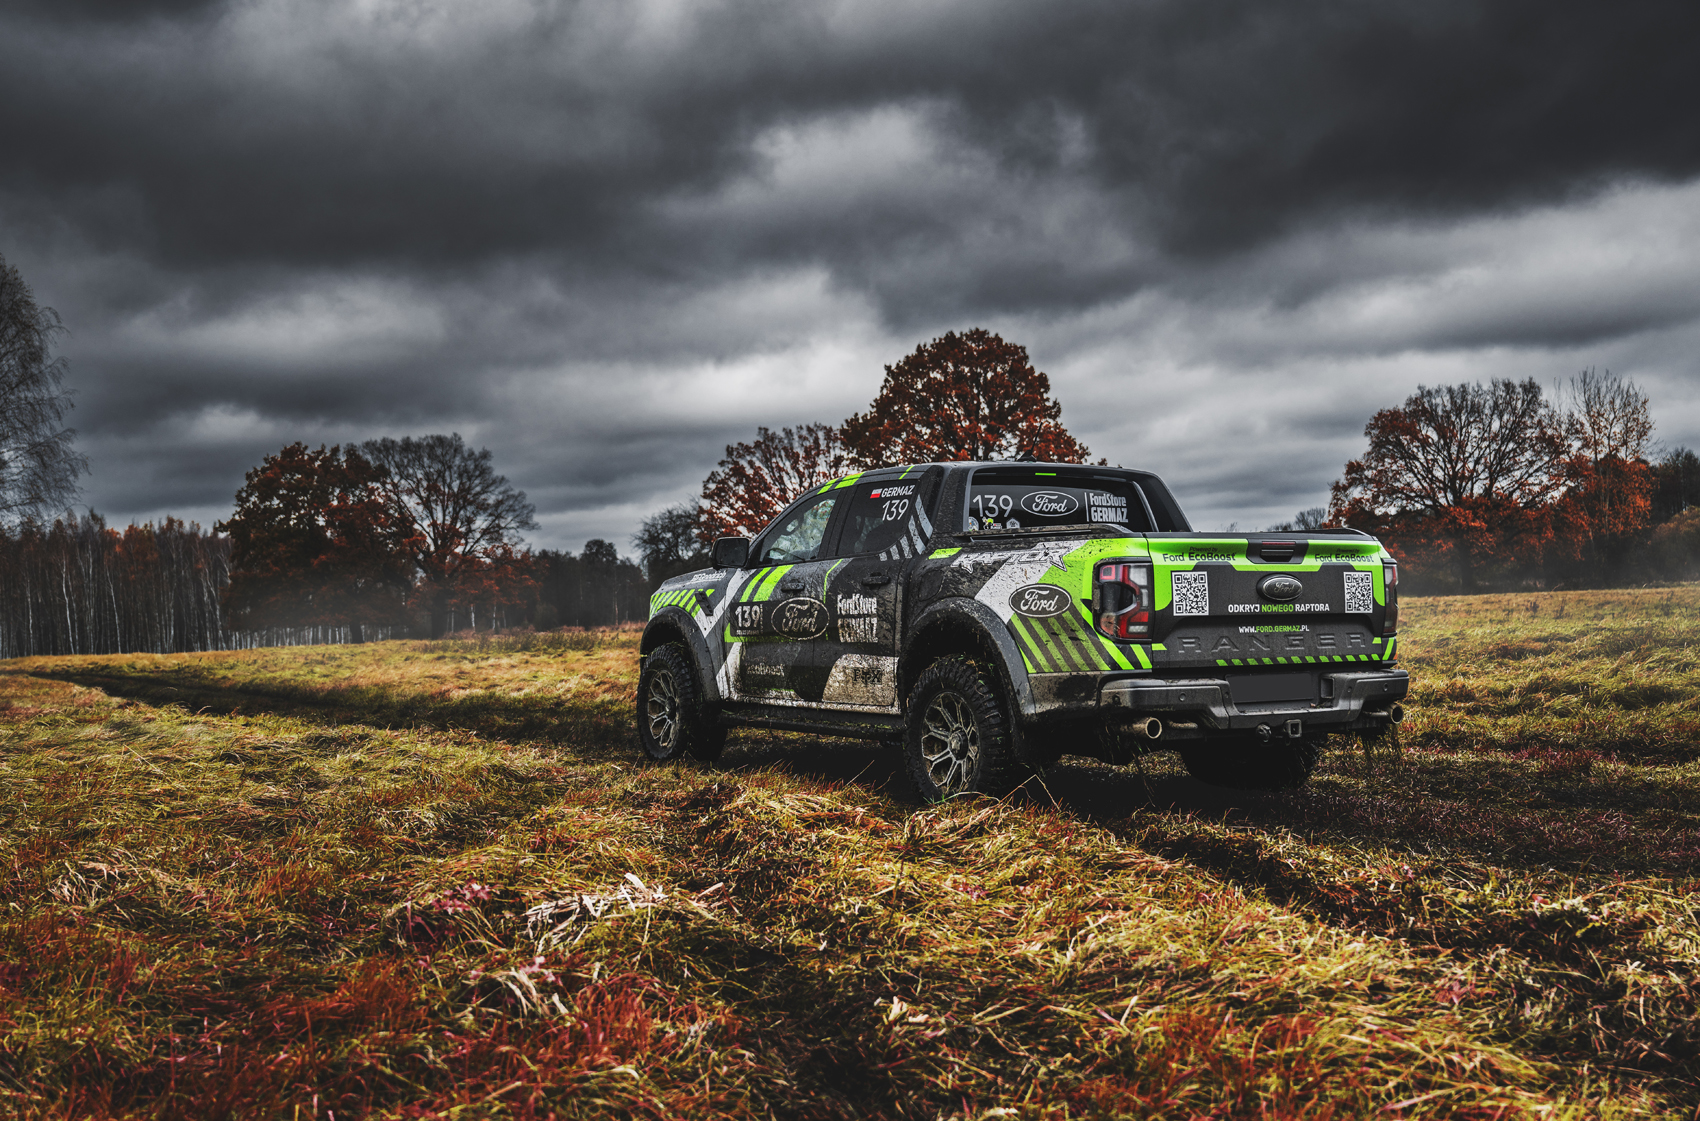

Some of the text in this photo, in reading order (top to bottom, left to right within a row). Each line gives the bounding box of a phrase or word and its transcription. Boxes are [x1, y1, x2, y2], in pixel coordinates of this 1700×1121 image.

[881, 484, 915, 498] GERMAZ
[1089, 493, 1127, 507] FordStore
[882, 499, 909, 520] 139
[972, 494, 1013, 518] 139
[1032, 494, 1068, 512] Ford
[1091, 507, 1128, 523] GERMAZ
[1162, 552, 1236, 562] Ford EcoBoost
[1315, 553, 1374, 562] Ford EcoBoost
[837, 594, 878, 615] FordStore
[1020, 588, 1058, 611] Ford
[1228, 603, 1330, 613] ODKRYJ NOWEGO RAPTORA
[735, 605, 760, 628] 139
[782, 603, 818, 632] Ford
[1239, 625, 1310, 633] WWW.FORD.GERMAZ.PL
[1177, 632, 1366, 653] RANGER
